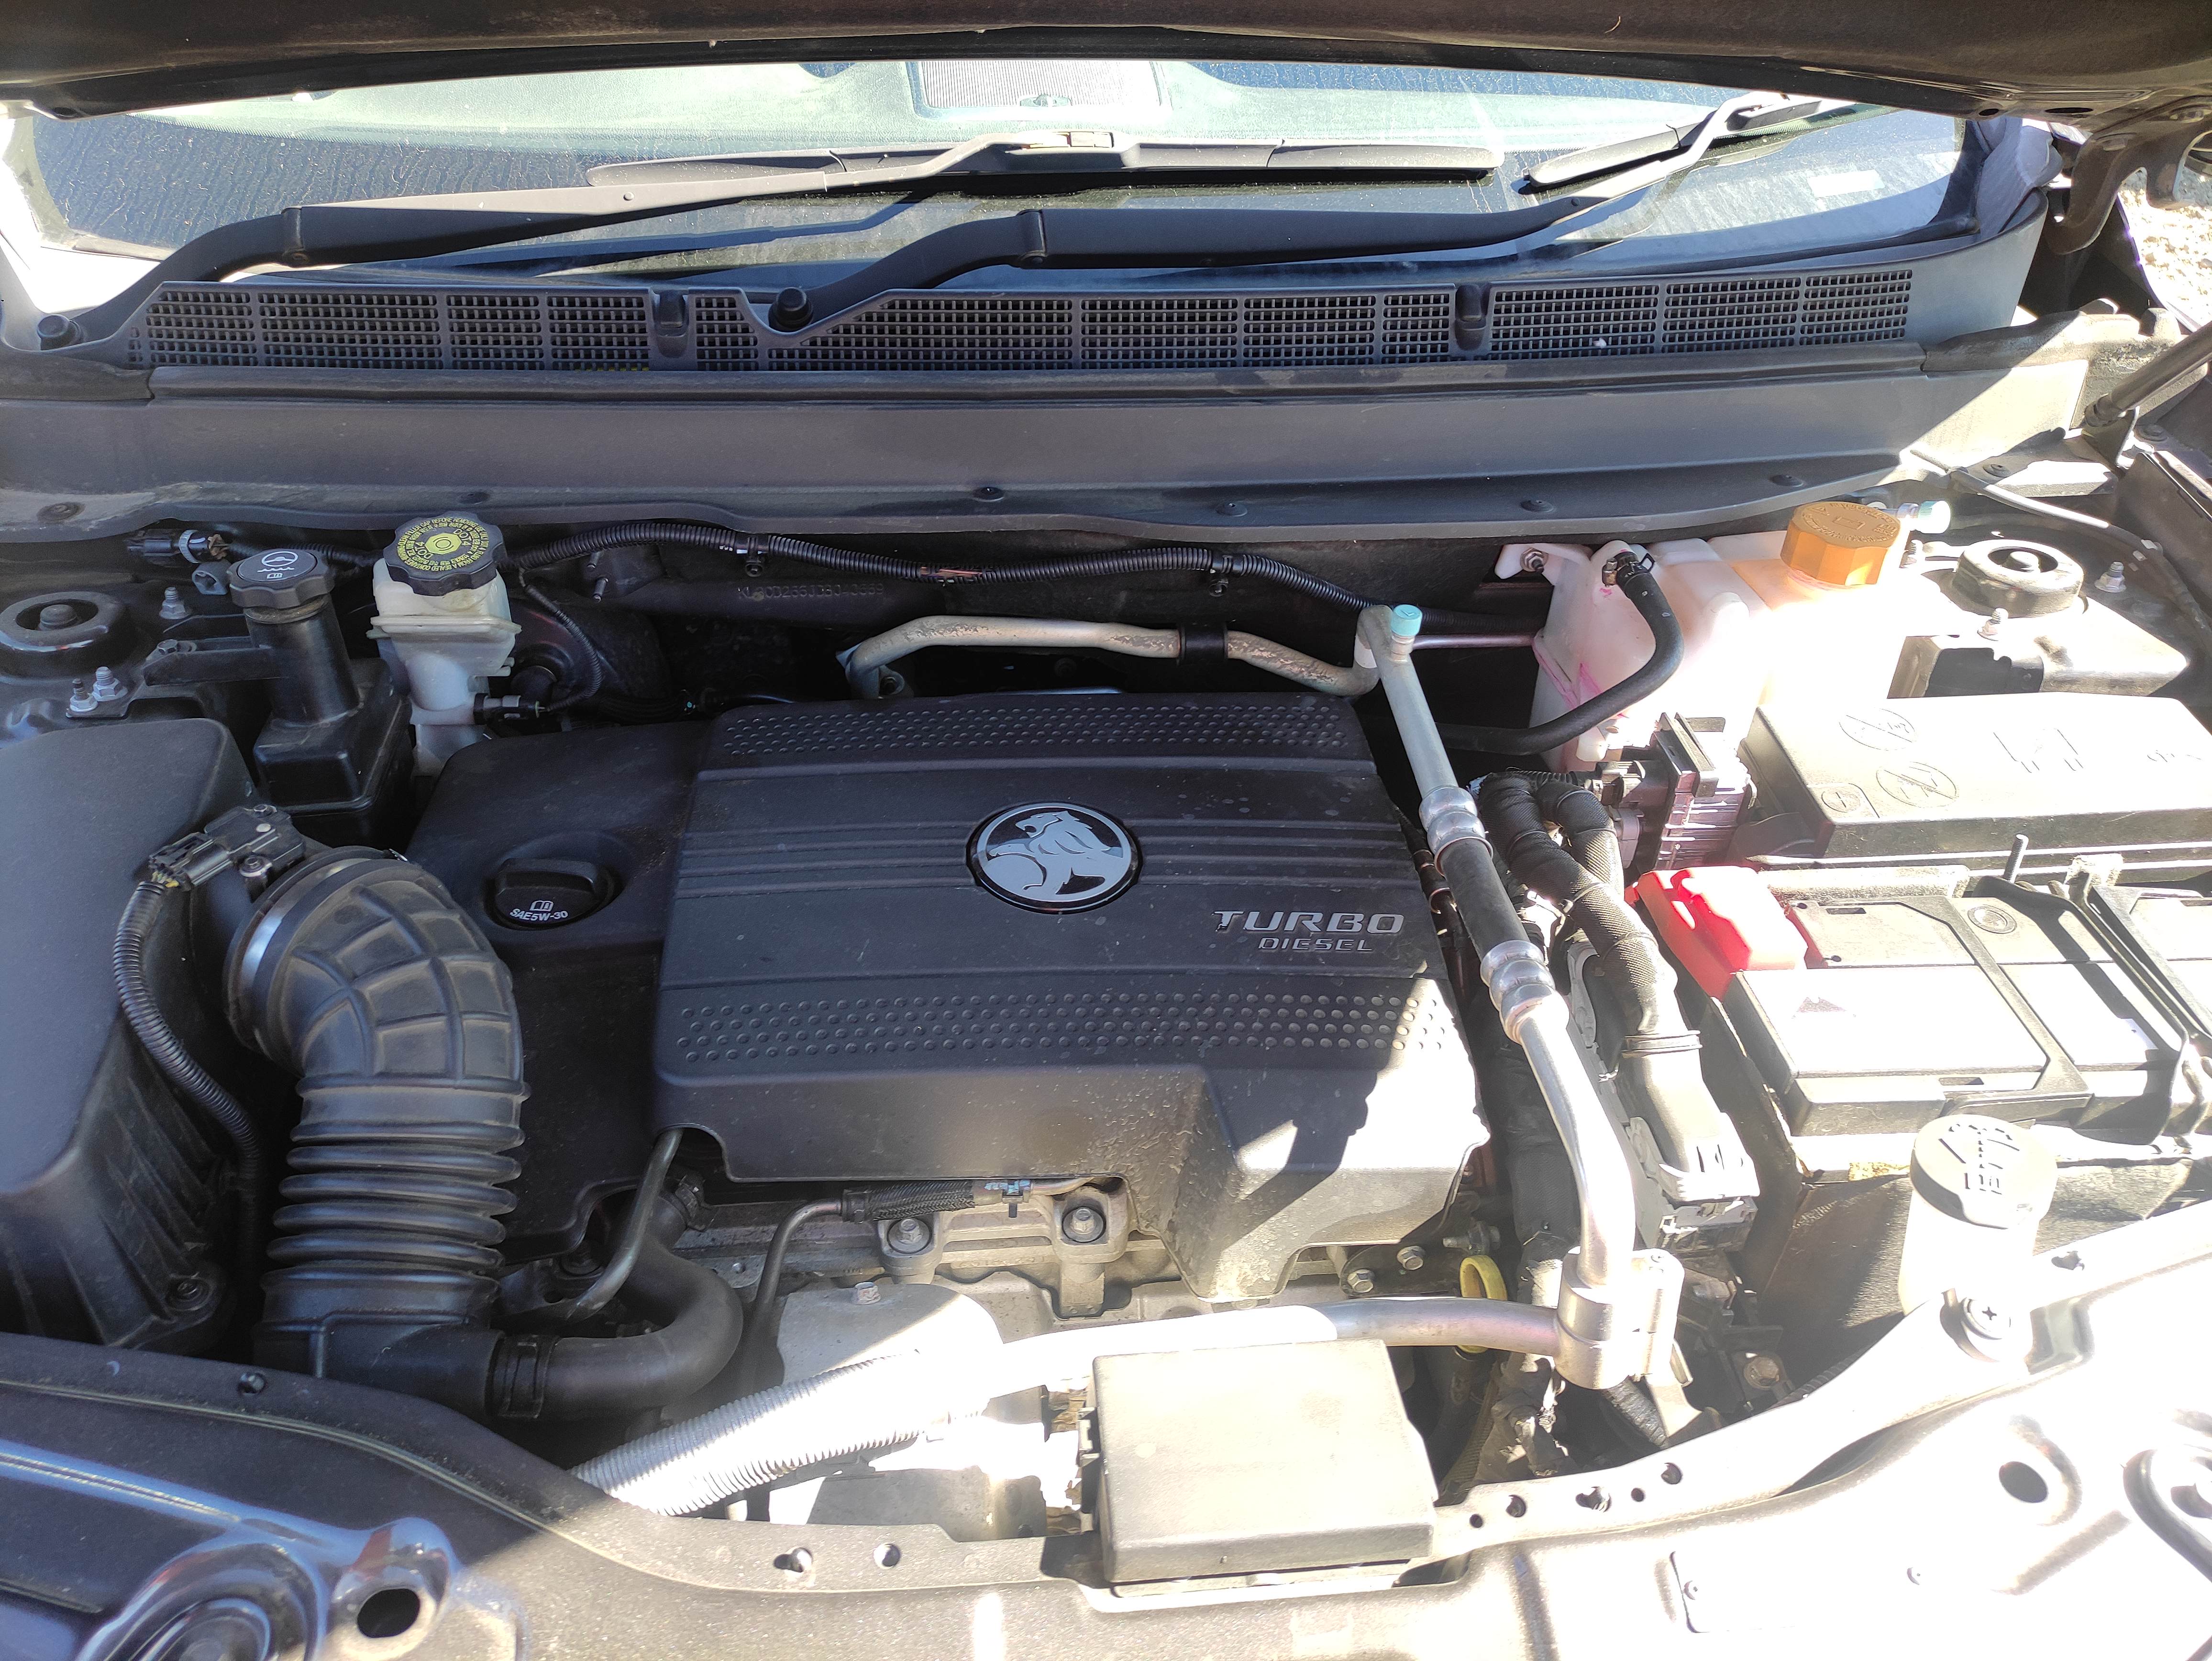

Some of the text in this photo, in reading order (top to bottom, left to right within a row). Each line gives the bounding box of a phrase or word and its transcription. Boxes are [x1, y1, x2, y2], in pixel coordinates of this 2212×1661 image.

[453, 518, 478, 528] REMOVING
[405, 525, 421, 536] FILLER
[453, 529, 472, 542] DOT
[479, 532, 488, 540] ONLY
[414, 546, 433, 559] DOT
[470, 550, 485, 560] FLUID
[404, 558, 431, 571] CONTAINER
[457, 558, 474, 568] FROM
[509, 908, 569, 921] SAE5W-30
[1212, 911, 1405, 934] TURBO
[1258, 938, 1372, 951] DIESEL
